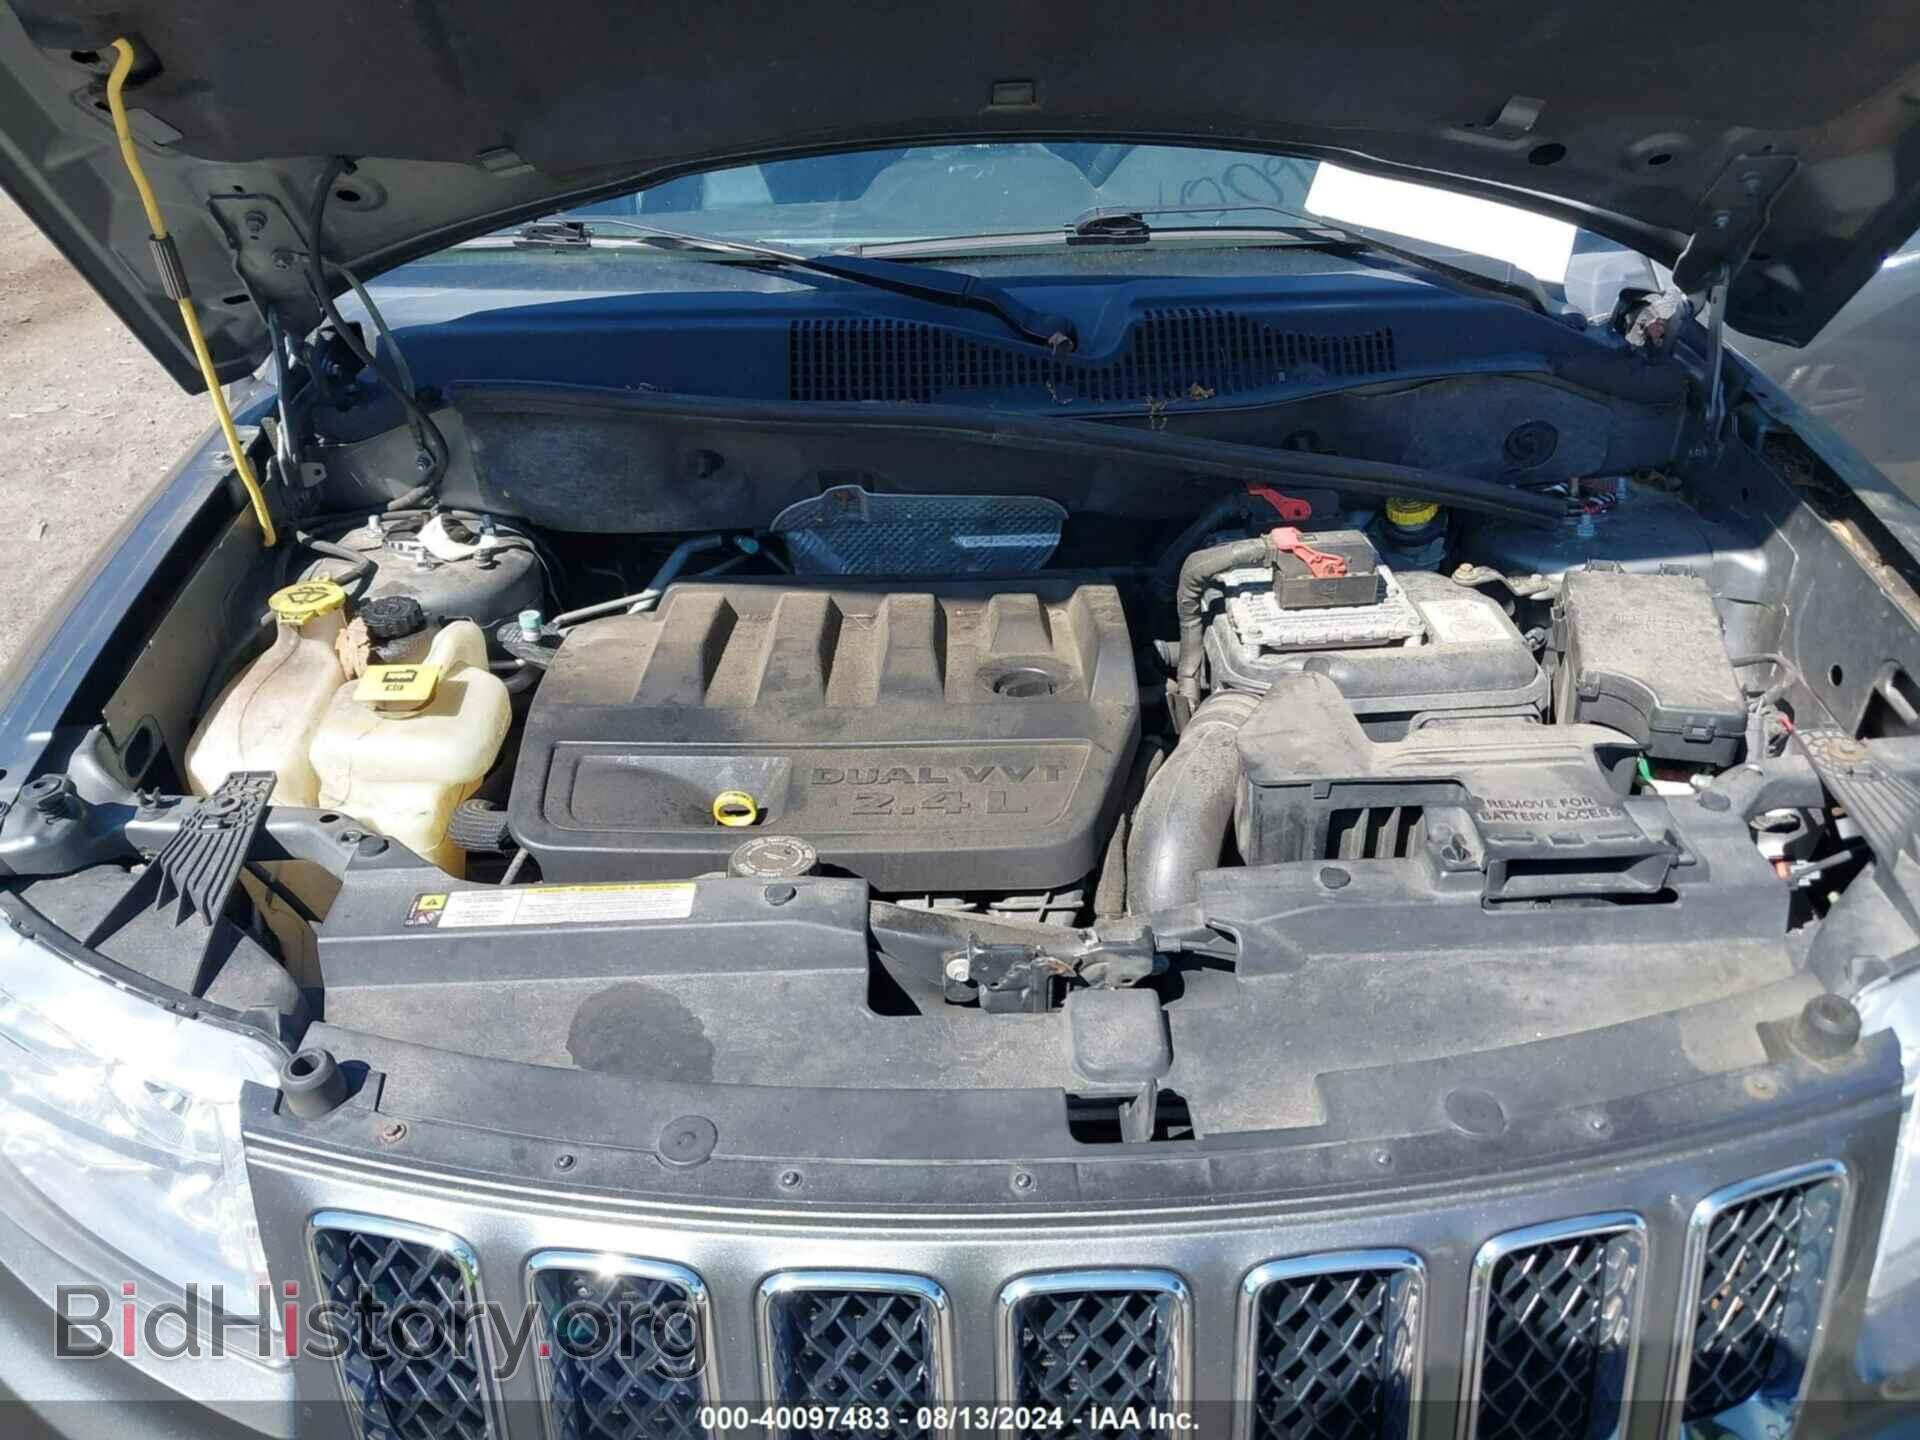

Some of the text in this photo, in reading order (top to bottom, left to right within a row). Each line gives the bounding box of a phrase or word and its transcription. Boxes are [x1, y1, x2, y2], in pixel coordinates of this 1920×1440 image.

[811, 765, 1067, 785] DUAL VVT
[852, 791, 1029, 815] 2.4L
[1484, 797, 1594, 809] REMOVE FOR
[1479, 807, 1623, 822] BATTERY ACCESS
